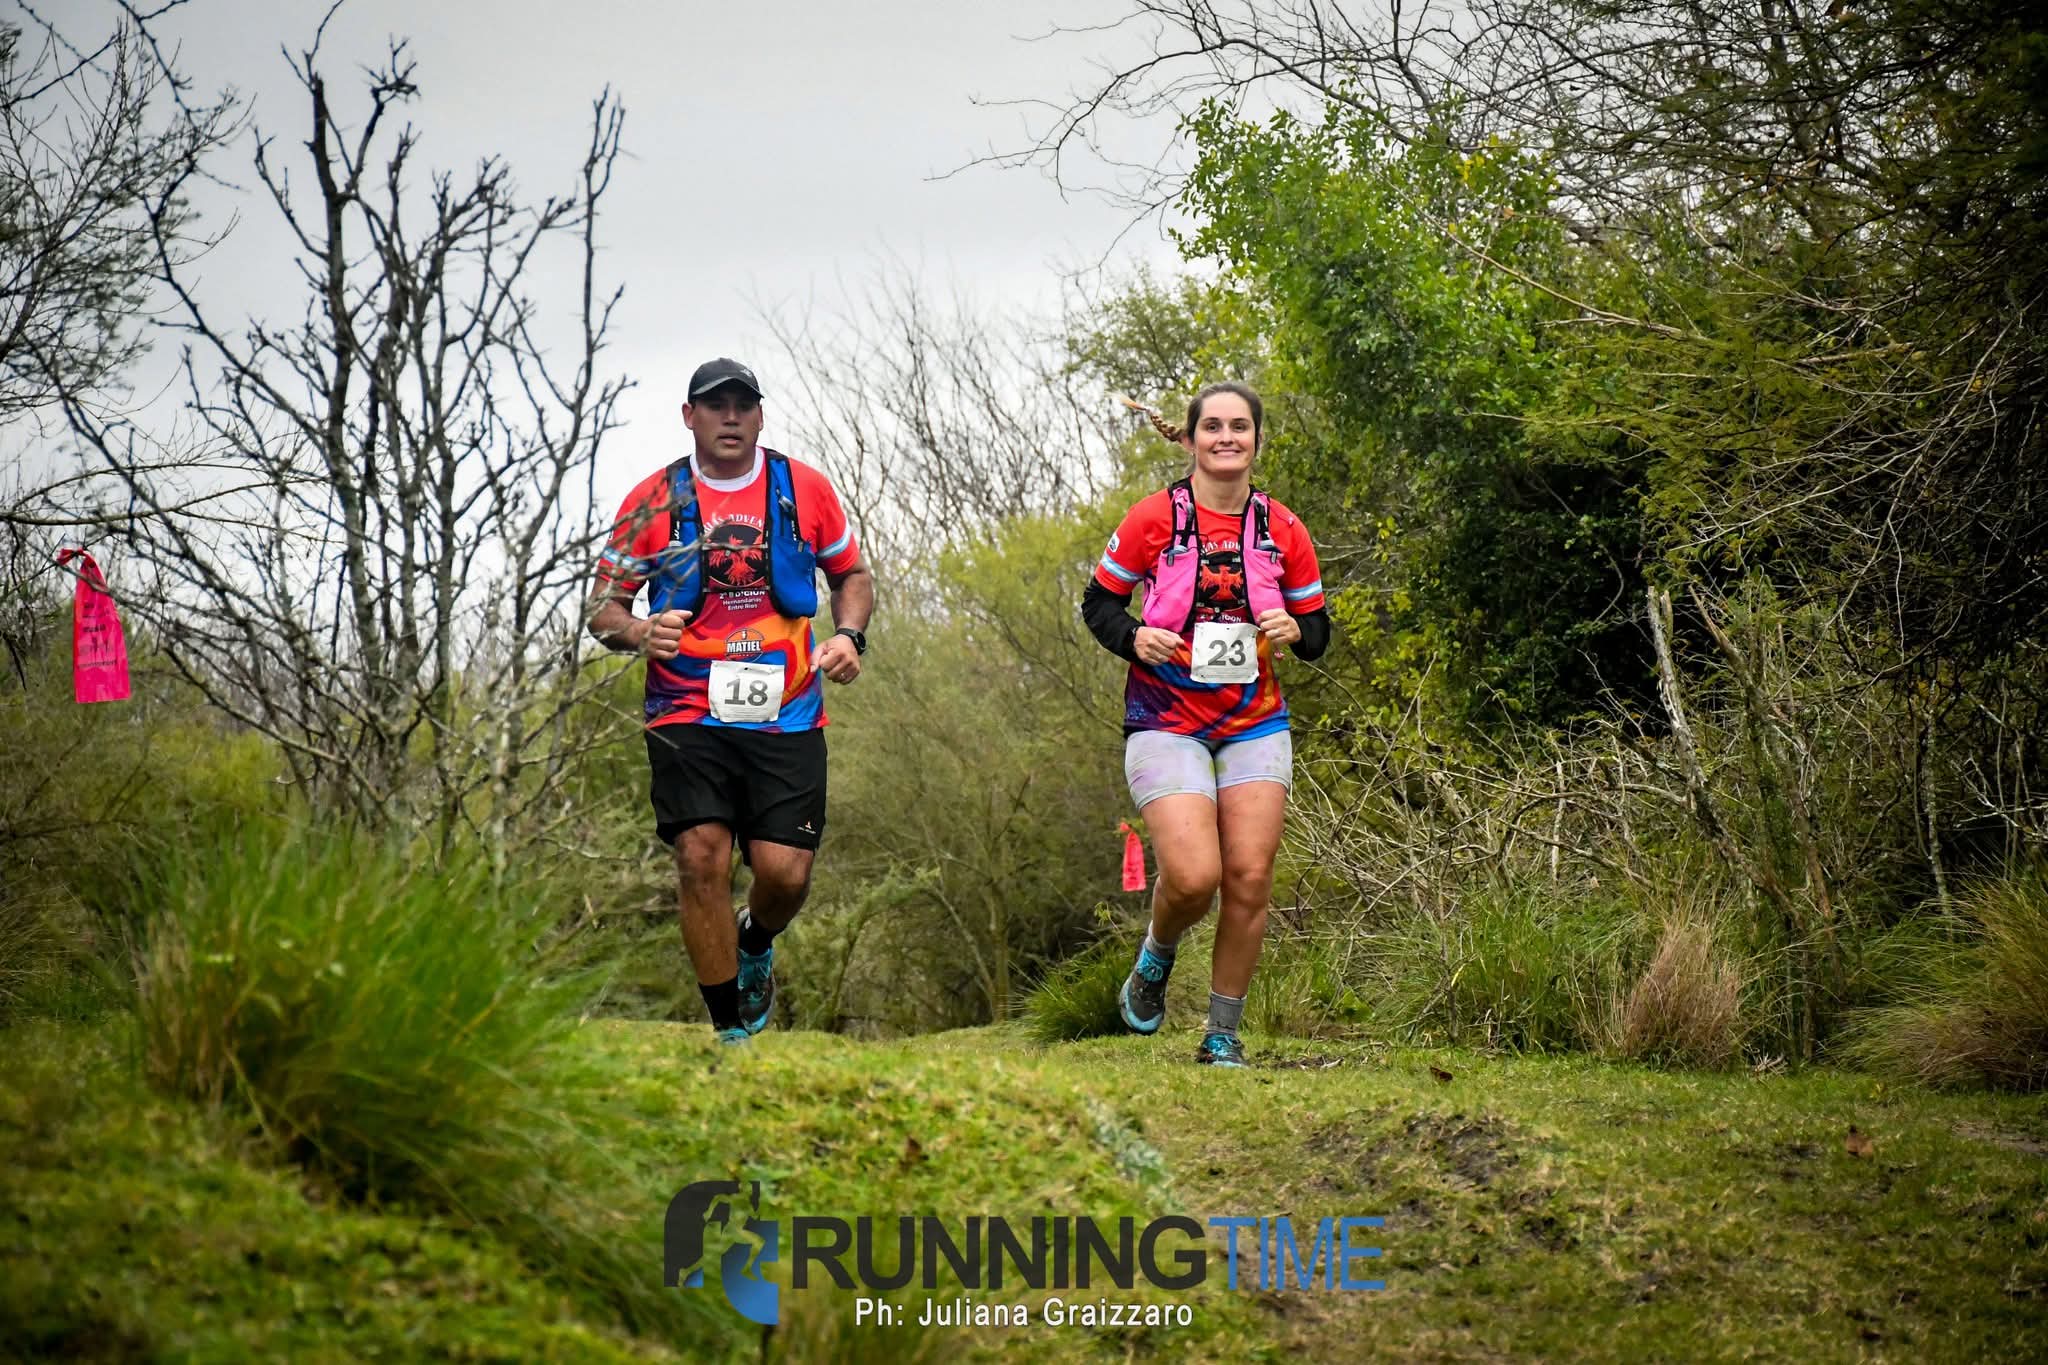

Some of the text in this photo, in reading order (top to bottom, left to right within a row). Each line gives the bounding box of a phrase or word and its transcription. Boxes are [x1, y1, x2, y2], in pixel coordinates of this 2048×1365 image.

[727, 640, 761, 653] MATIEL
[1208, 639, 1246, 666] 23
[725, 678, 768, 707] 18
